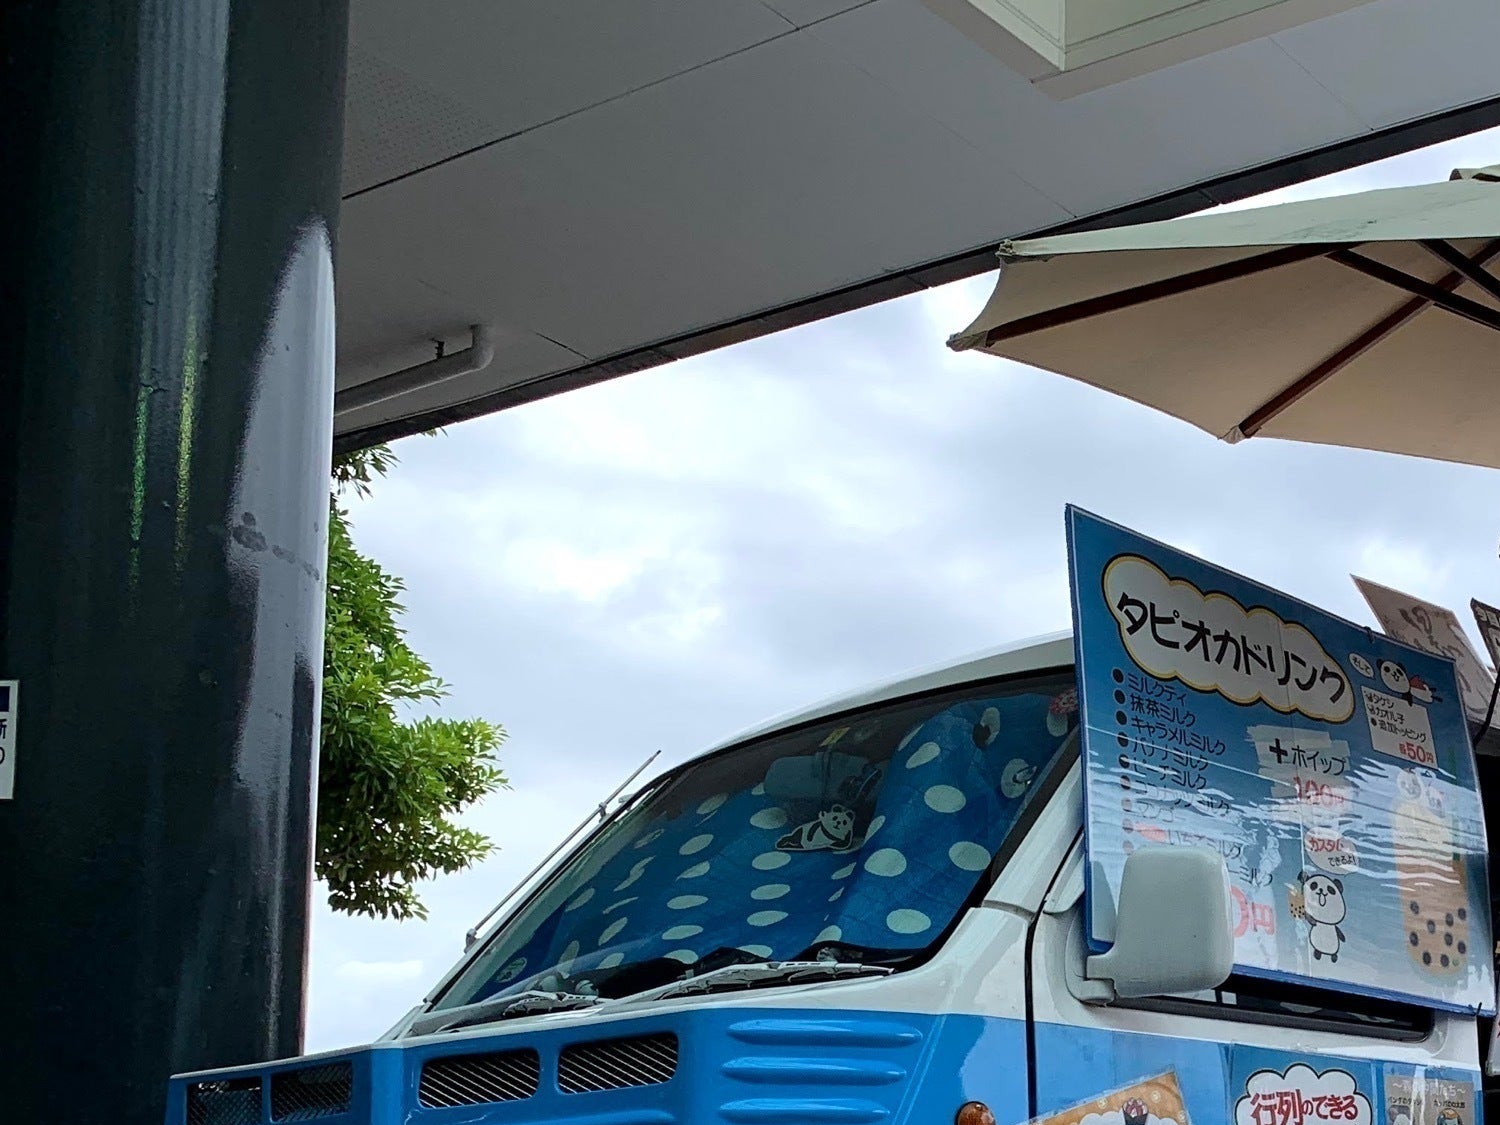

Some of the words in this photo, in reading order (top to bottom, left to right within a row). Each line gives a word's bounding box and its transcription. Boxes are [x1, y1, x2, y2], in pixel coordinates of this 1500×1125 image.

[1117, 592, 1346, 703] タピオカドリンク
[1130, 693, 1196, 727] 抹茶ミルク
[1131, 716, 1226, 756] キャラメルミルク
[1379, 720, 1427, 743] 追加トッピング
[1132, 737, 1209, 771] バナナミルク
[1399, 742, 1434, 764] 各50円
[1132, 757, 1208, 790] ピーチミルク
